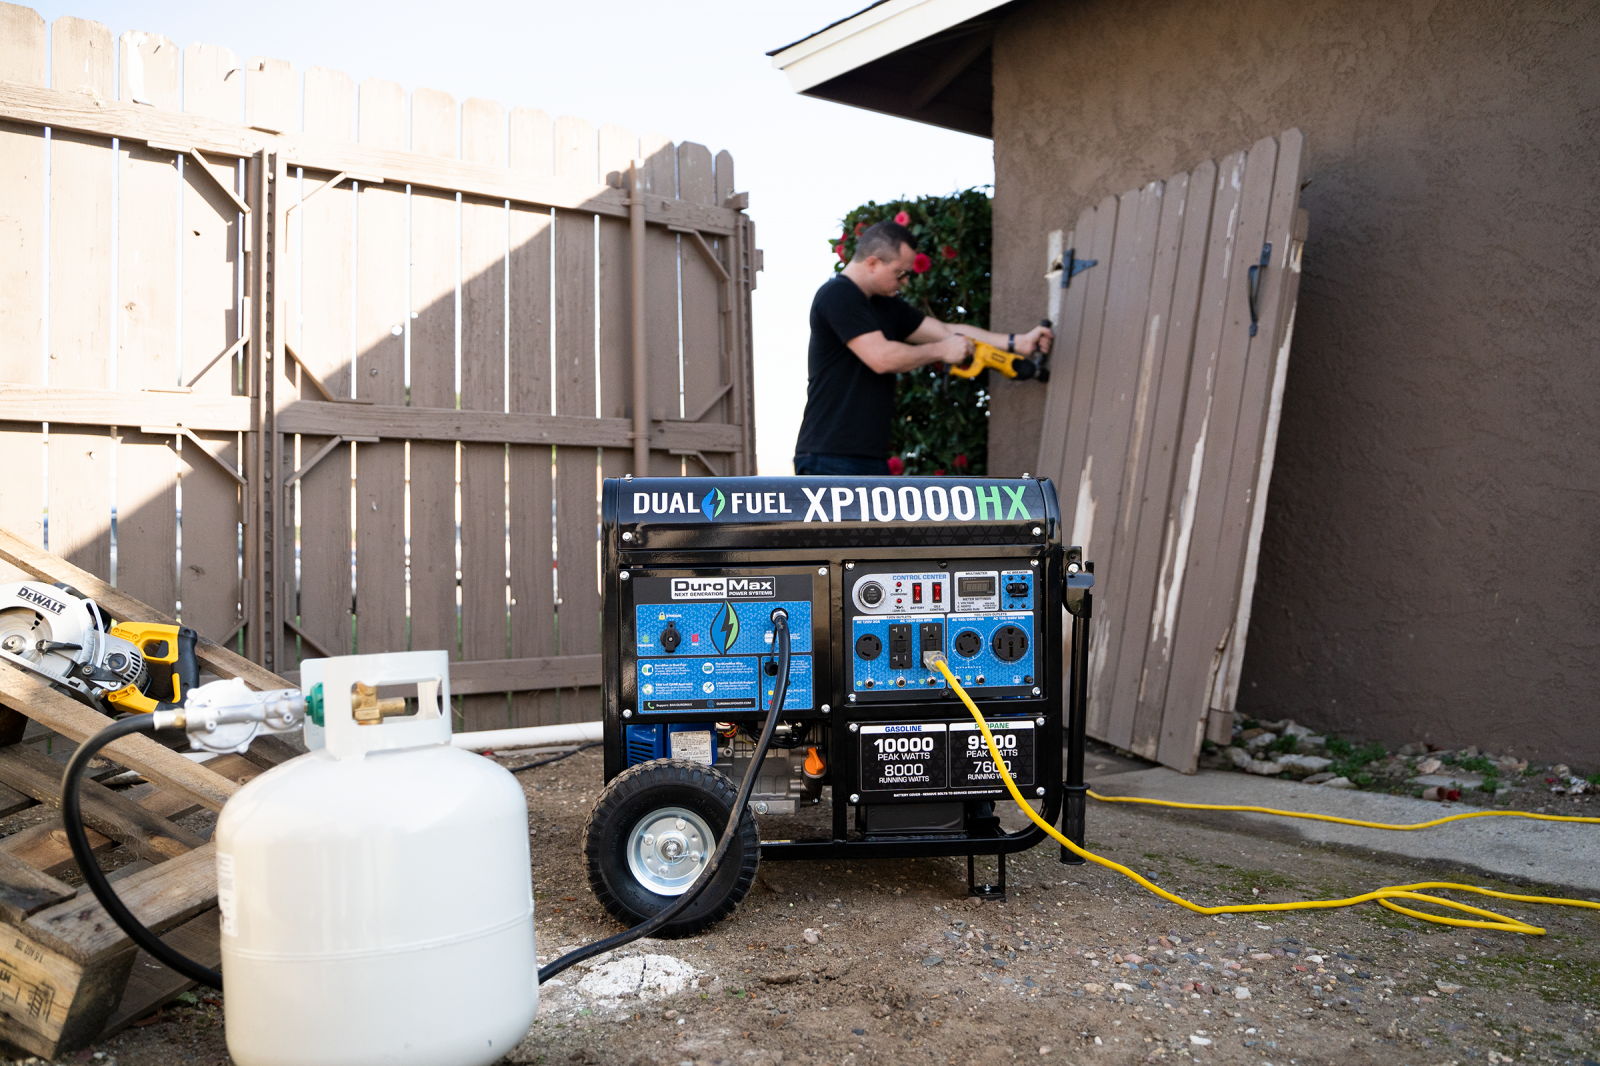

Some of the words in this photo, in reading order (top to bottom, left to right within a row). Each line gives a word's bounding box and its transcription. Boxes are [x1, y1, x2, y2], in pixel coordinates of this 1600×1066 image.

[633, 492, 700, 515] DUAL
[731, 492, 792, 514] FUEL
[801, 485, 1031, 523] XP10000HX
[885, 725, 922, 733] GASOLINE
[873, 737, 934, 753] 10000
[967, 734, 1017, 750] 9500
[877, 753, 900, 761] PEAK
[901, 752, 930, 760] WATTS
[966, 750, 988, 758] PEAK
[989, 749, 1018, 757] ATTS
[884, 763, 924, 777] 8000
[973, 760, 1012, 774] 7600
[879, 776, 907, 784] RUNNING
[908, 775, 929, 783] WATTS
